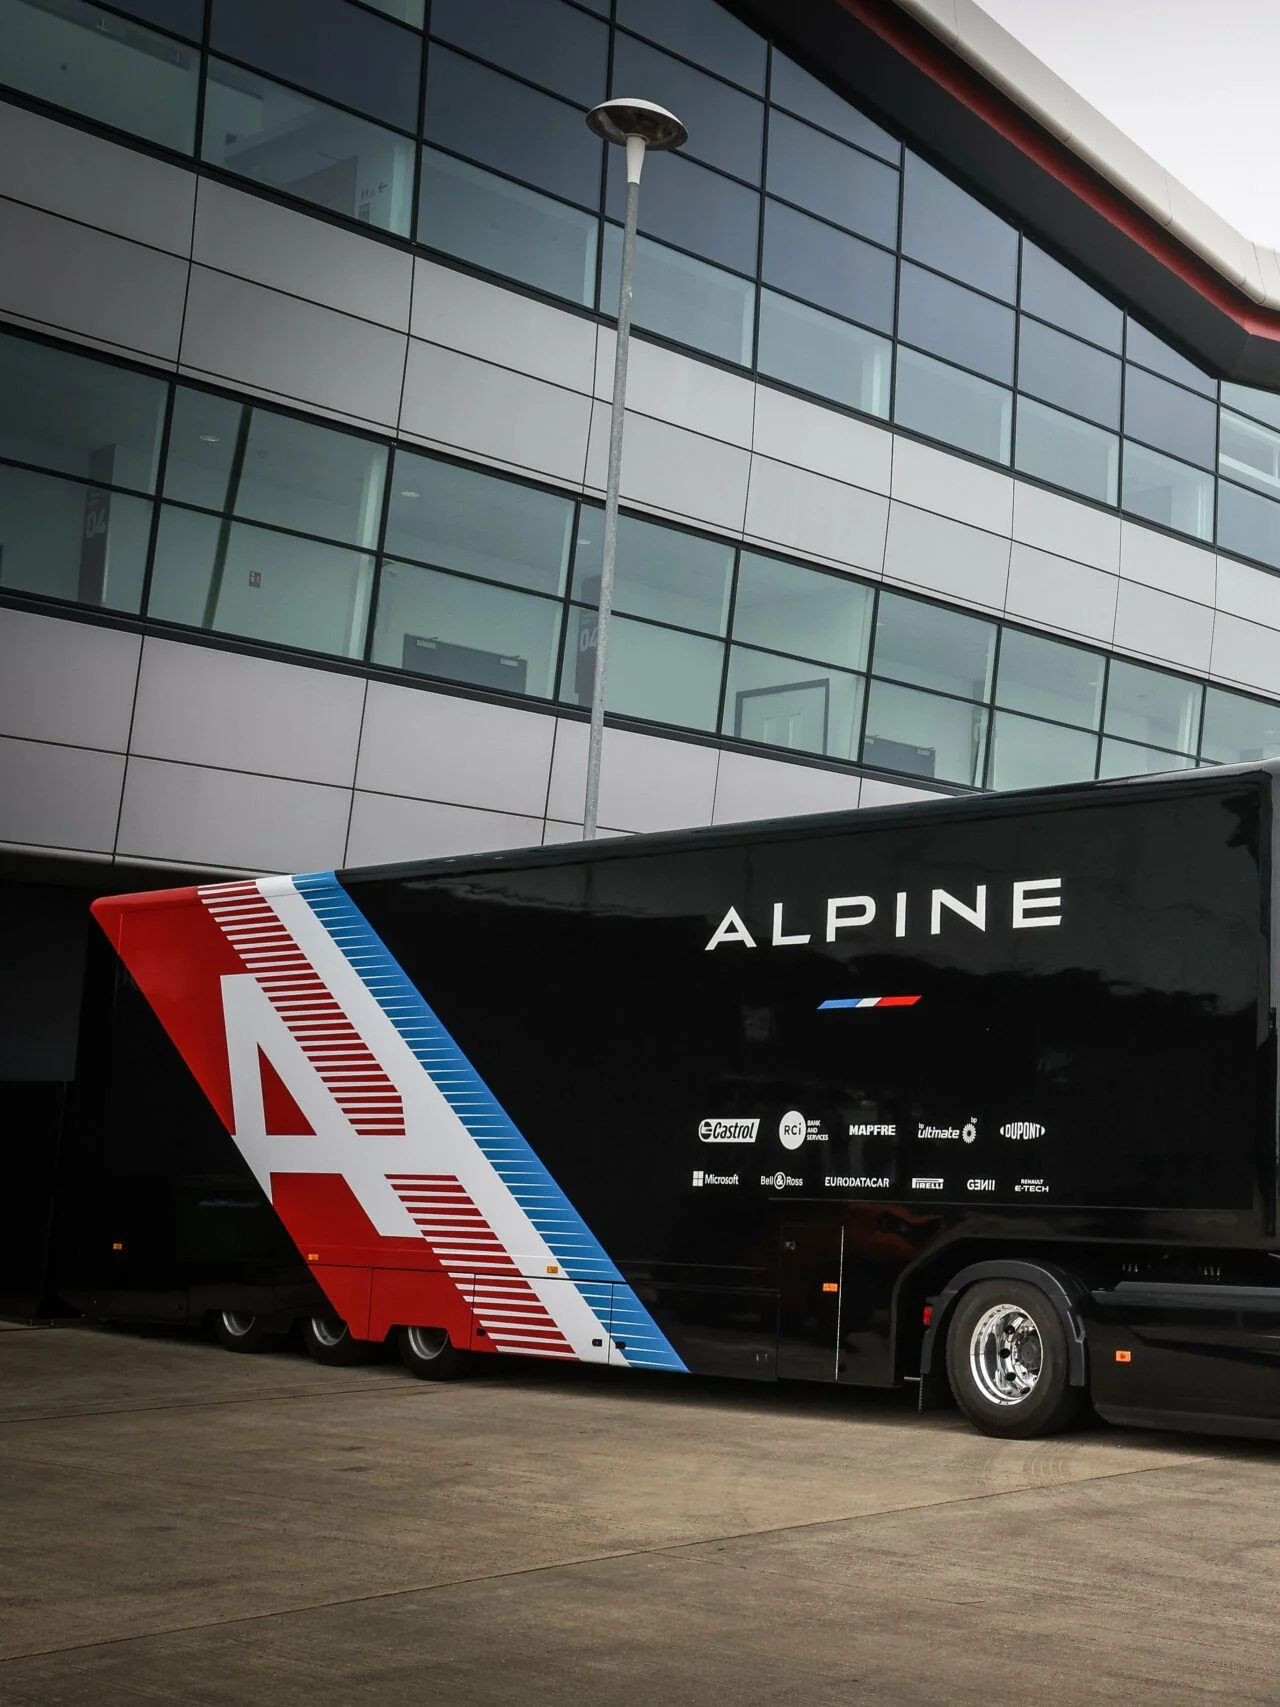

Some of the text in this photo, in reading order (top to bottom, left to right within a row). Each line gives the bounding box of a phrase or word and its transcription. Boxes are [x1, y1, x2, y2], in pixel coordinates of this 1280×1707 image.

[86, 508, 107, 539] 04
[704, 877, 1062, 951] ALPINE
[807, 1119, 821, 1127] BANK
[918, 1122, 925, 1130] bp
[970, 1116, 978, 1124] bp
[712, 1121, 754, 1140] Castrol
[849, 1124, 896, 1136] MAPFRE
[917, 1126, 960, 1140] ultimate
[1005, 1122, 1041, 1140] DUPONT
[705, 1173, 739, 1185] Microsoft
[825, 1175, 889, 1188] EURODATACAR
[911, 1177, 944, 1190] PIRELLI
[1014, 1185, 1049, 1193] E-TECH
